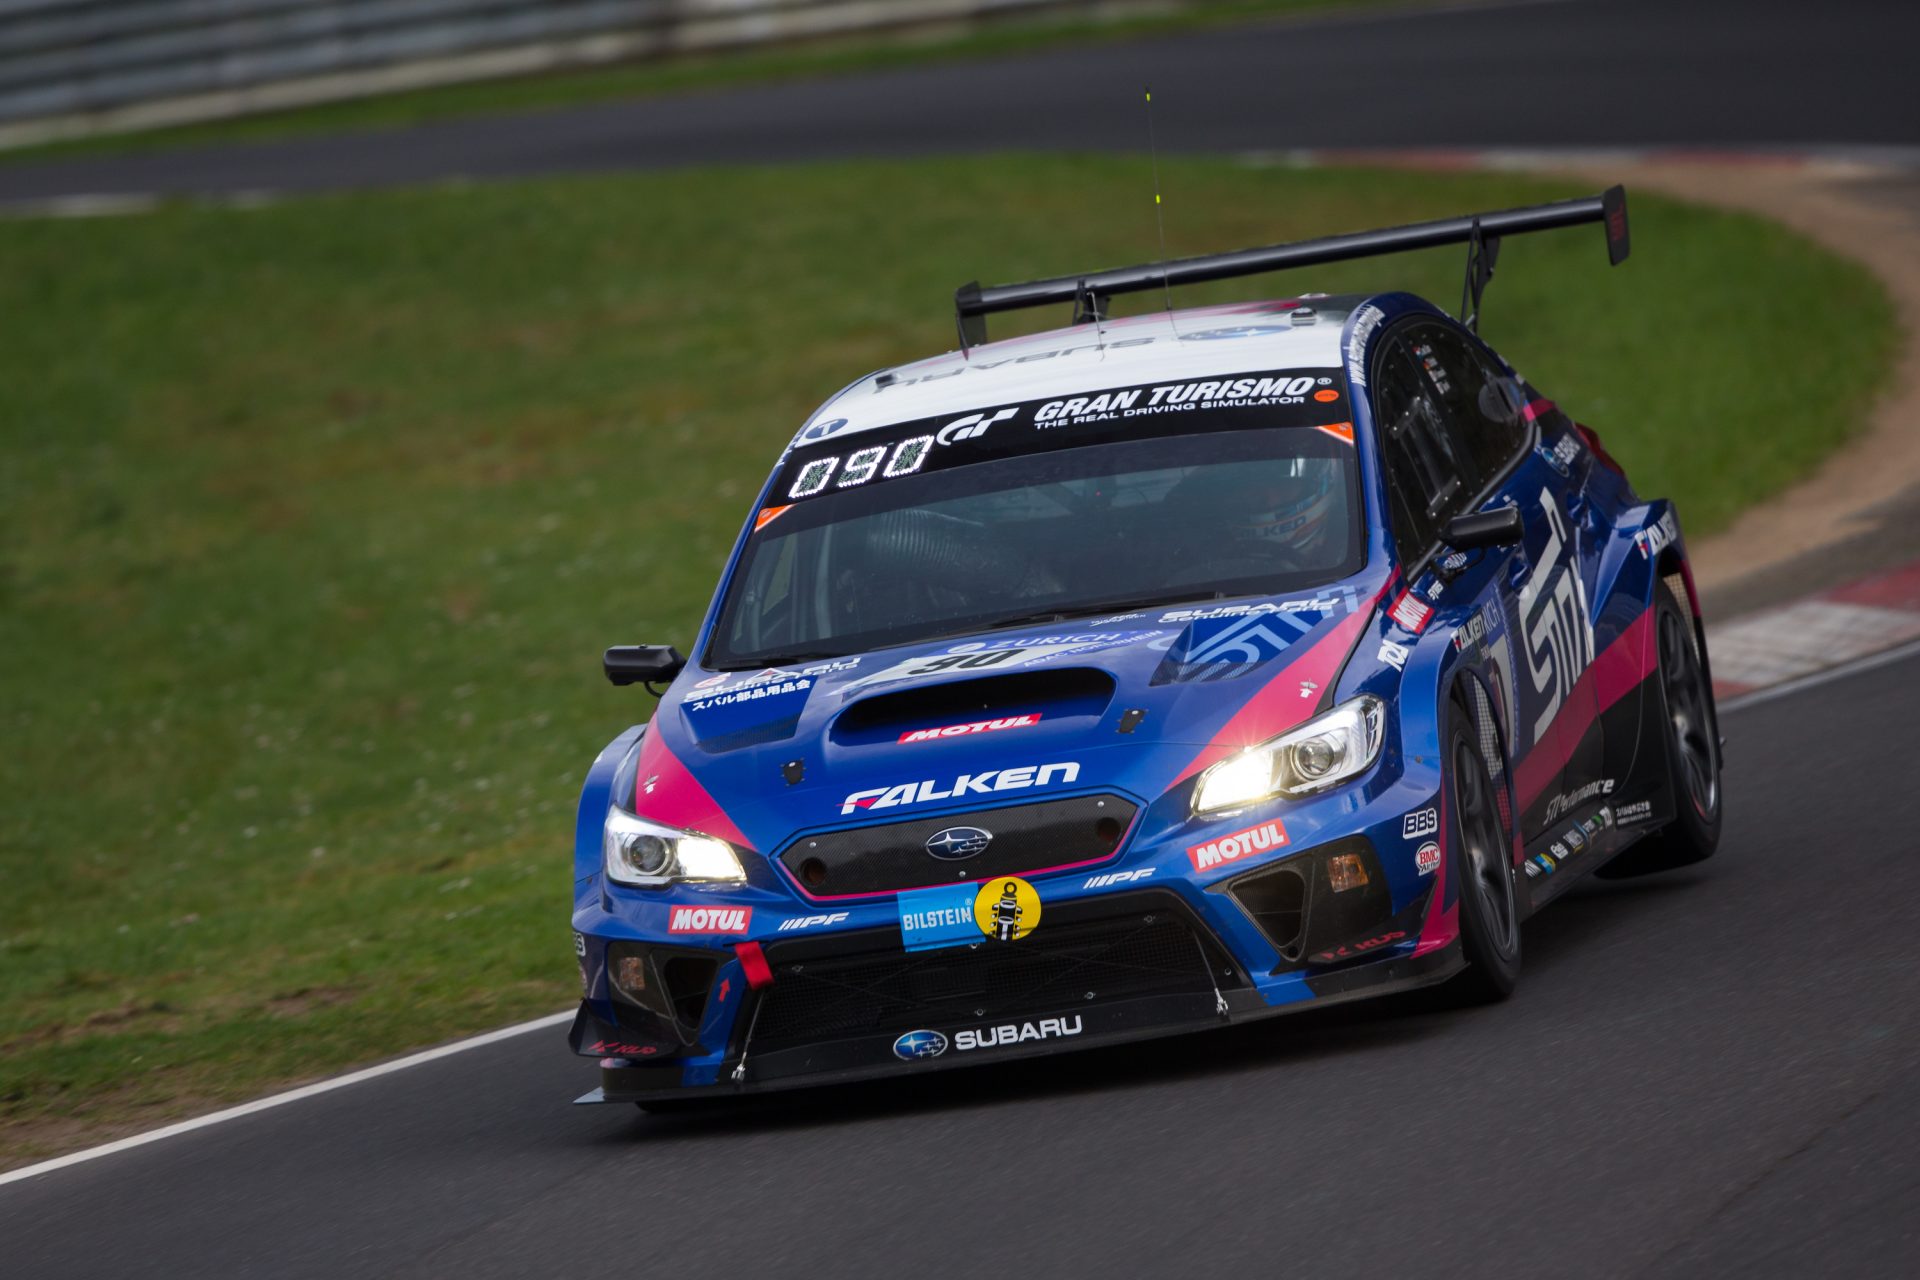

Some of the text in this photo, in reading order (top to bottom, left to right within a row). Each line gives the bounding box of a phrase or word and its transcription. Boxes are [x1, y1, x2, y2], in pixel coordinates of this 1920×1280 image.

[1034, 376, 1316, 423] GRAN TURISMO
[1034, 396, 1305, 430] THE REAL DRIVING SIMULATOR
[788, 434, 935, 498] 090
[1162, 598, 1339, 619] SUBARU
[989, 633, 1123, 649] ZURICH
[908, 649, 1028, 675] 90
[904, 715, 1033, 742] MOTUL
[840, 761, 1080, 815] FALKEN
[1404, 809, 1436, 838] BBS
[1196, 824, 1284, 868] MOTUL
[1420, 849, 1438, 864] BMC
[671, 909, 746, 931] MOTUL
[902, 907, 972, 931] BILSTEIN
[955, 1015, 1082, 1050] SUBARU
